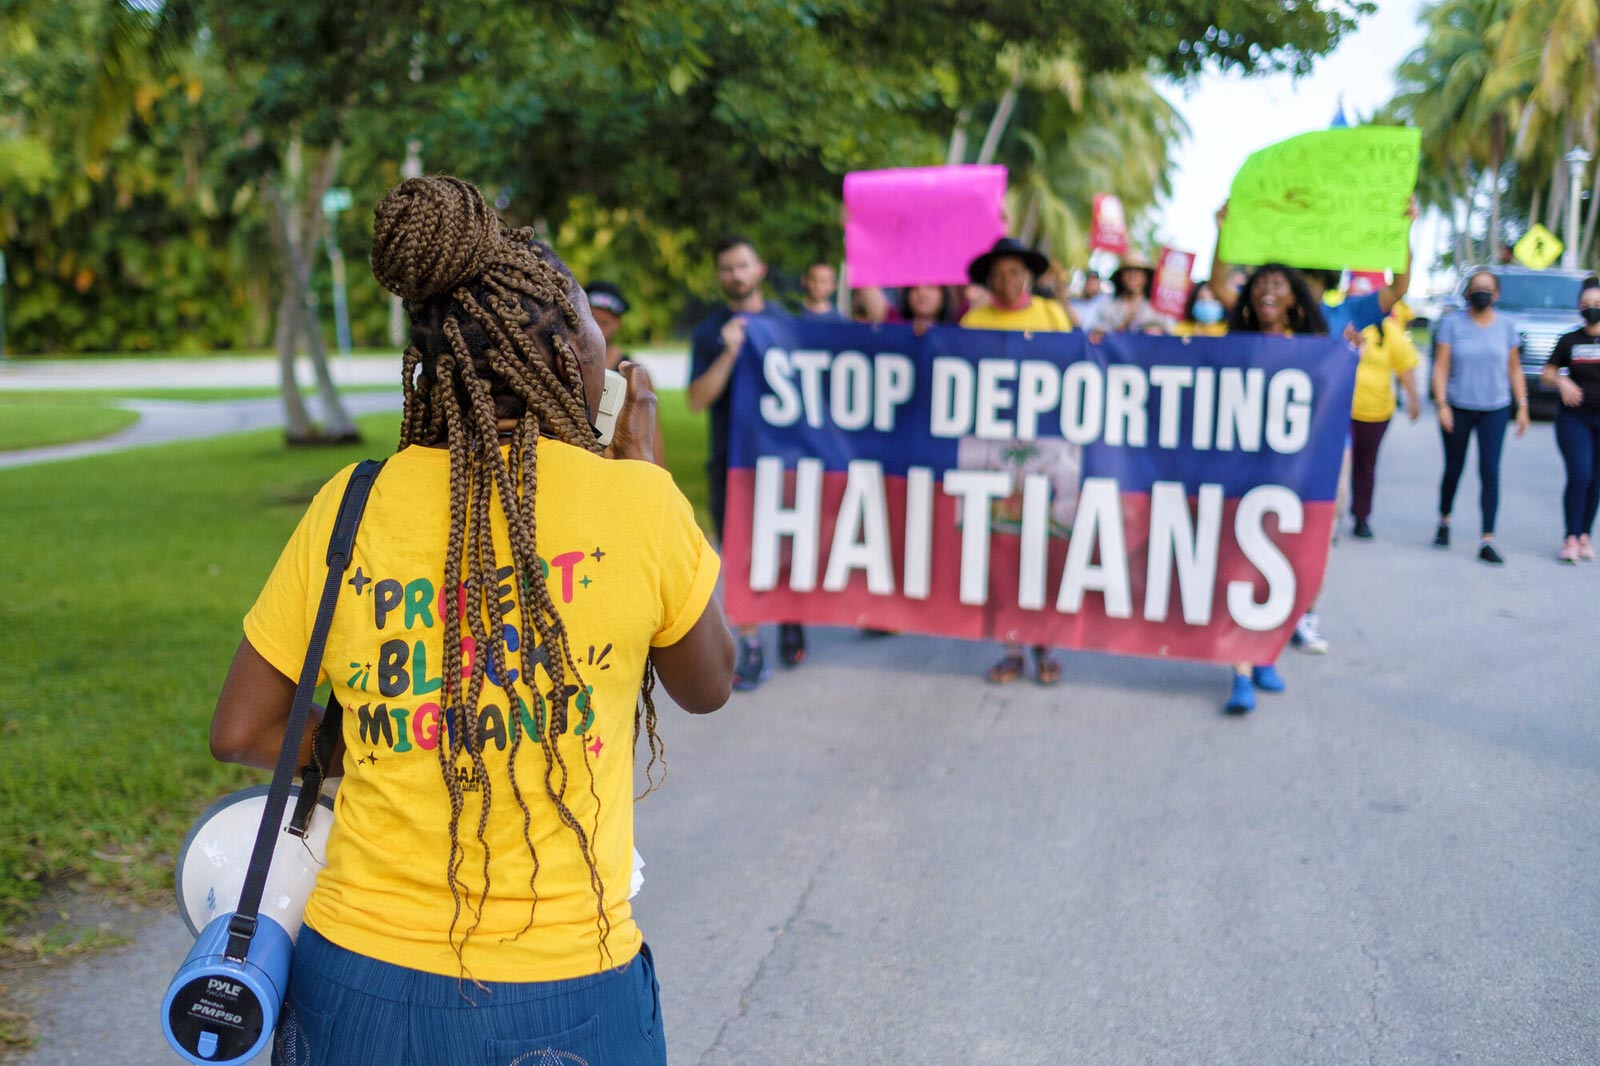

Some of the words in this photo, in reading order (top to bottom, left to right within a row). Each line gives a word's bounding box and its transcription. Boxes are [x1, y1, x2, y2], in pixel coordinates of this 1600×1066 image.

[760, 347, 914, 432] STOP
[930, 356, 1312, 454] DEPORTING
[750, 456, 1304, 632] HAITIANS
[191, 1003, 242, 1024] PMP50
